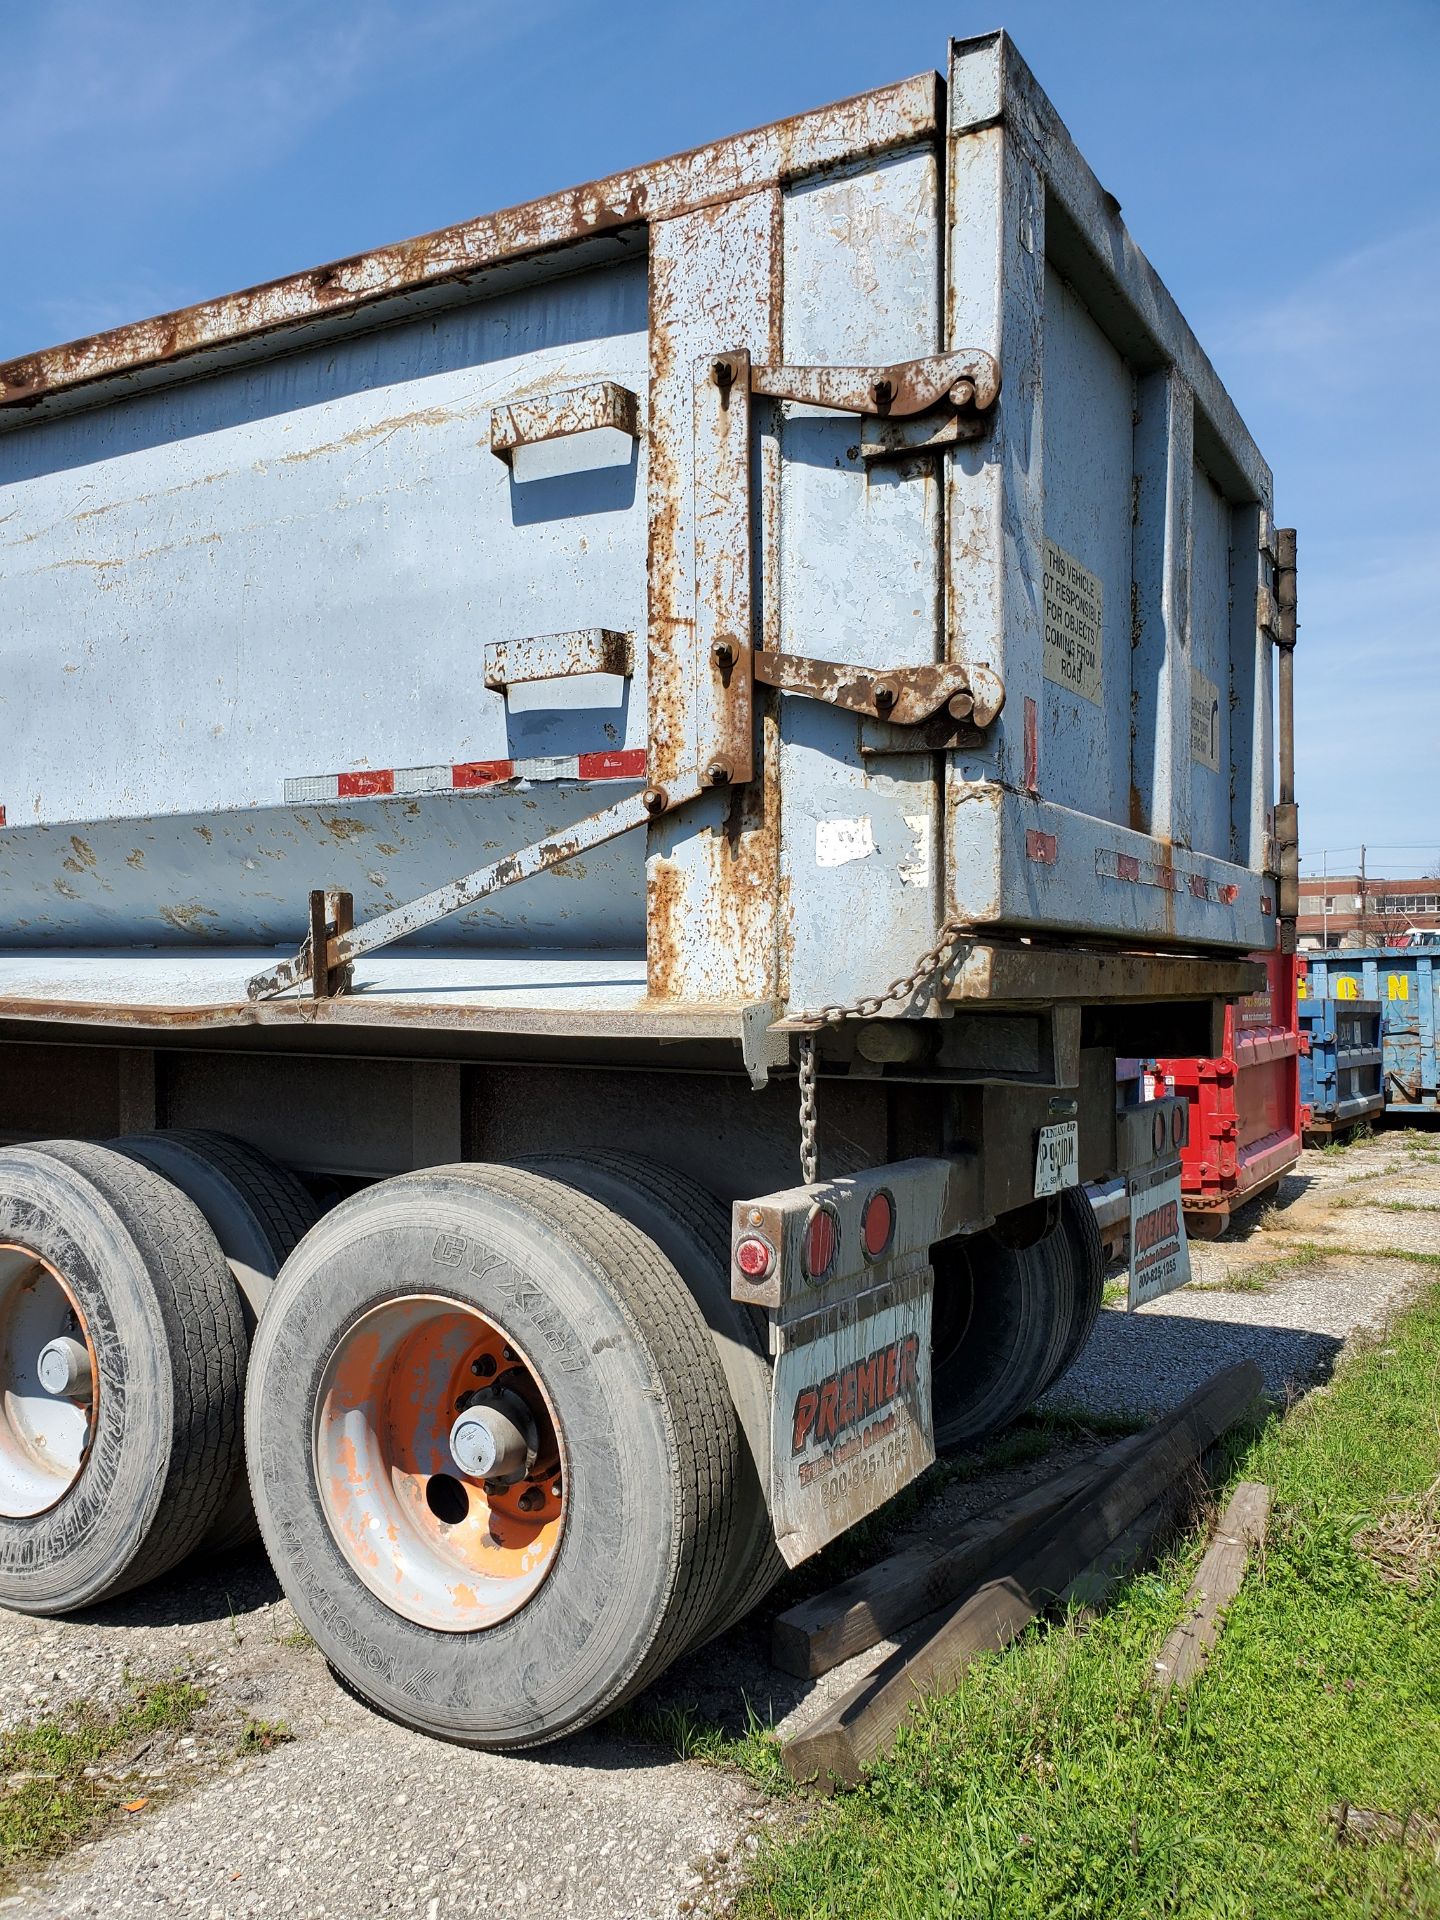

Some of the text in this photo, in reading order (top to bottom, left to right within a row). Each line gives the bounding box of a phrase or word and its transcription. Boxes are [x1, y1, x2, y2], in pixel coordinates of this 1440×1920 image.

[1048, 550, 1094, 598] THIS VEHICLE
[1043, 572, 1101, 626] OT RESPONSIBLE
[1047, 600, 1094, 645] FOR OBJECTS
[1045, 625, 1095, 669] COMING FROM
[1061, 658, 1081, 683] ROAD
[792, 1333, 919, 1456] PREMIER
[279, 1518, 398, 1685] YOKOHAMA
